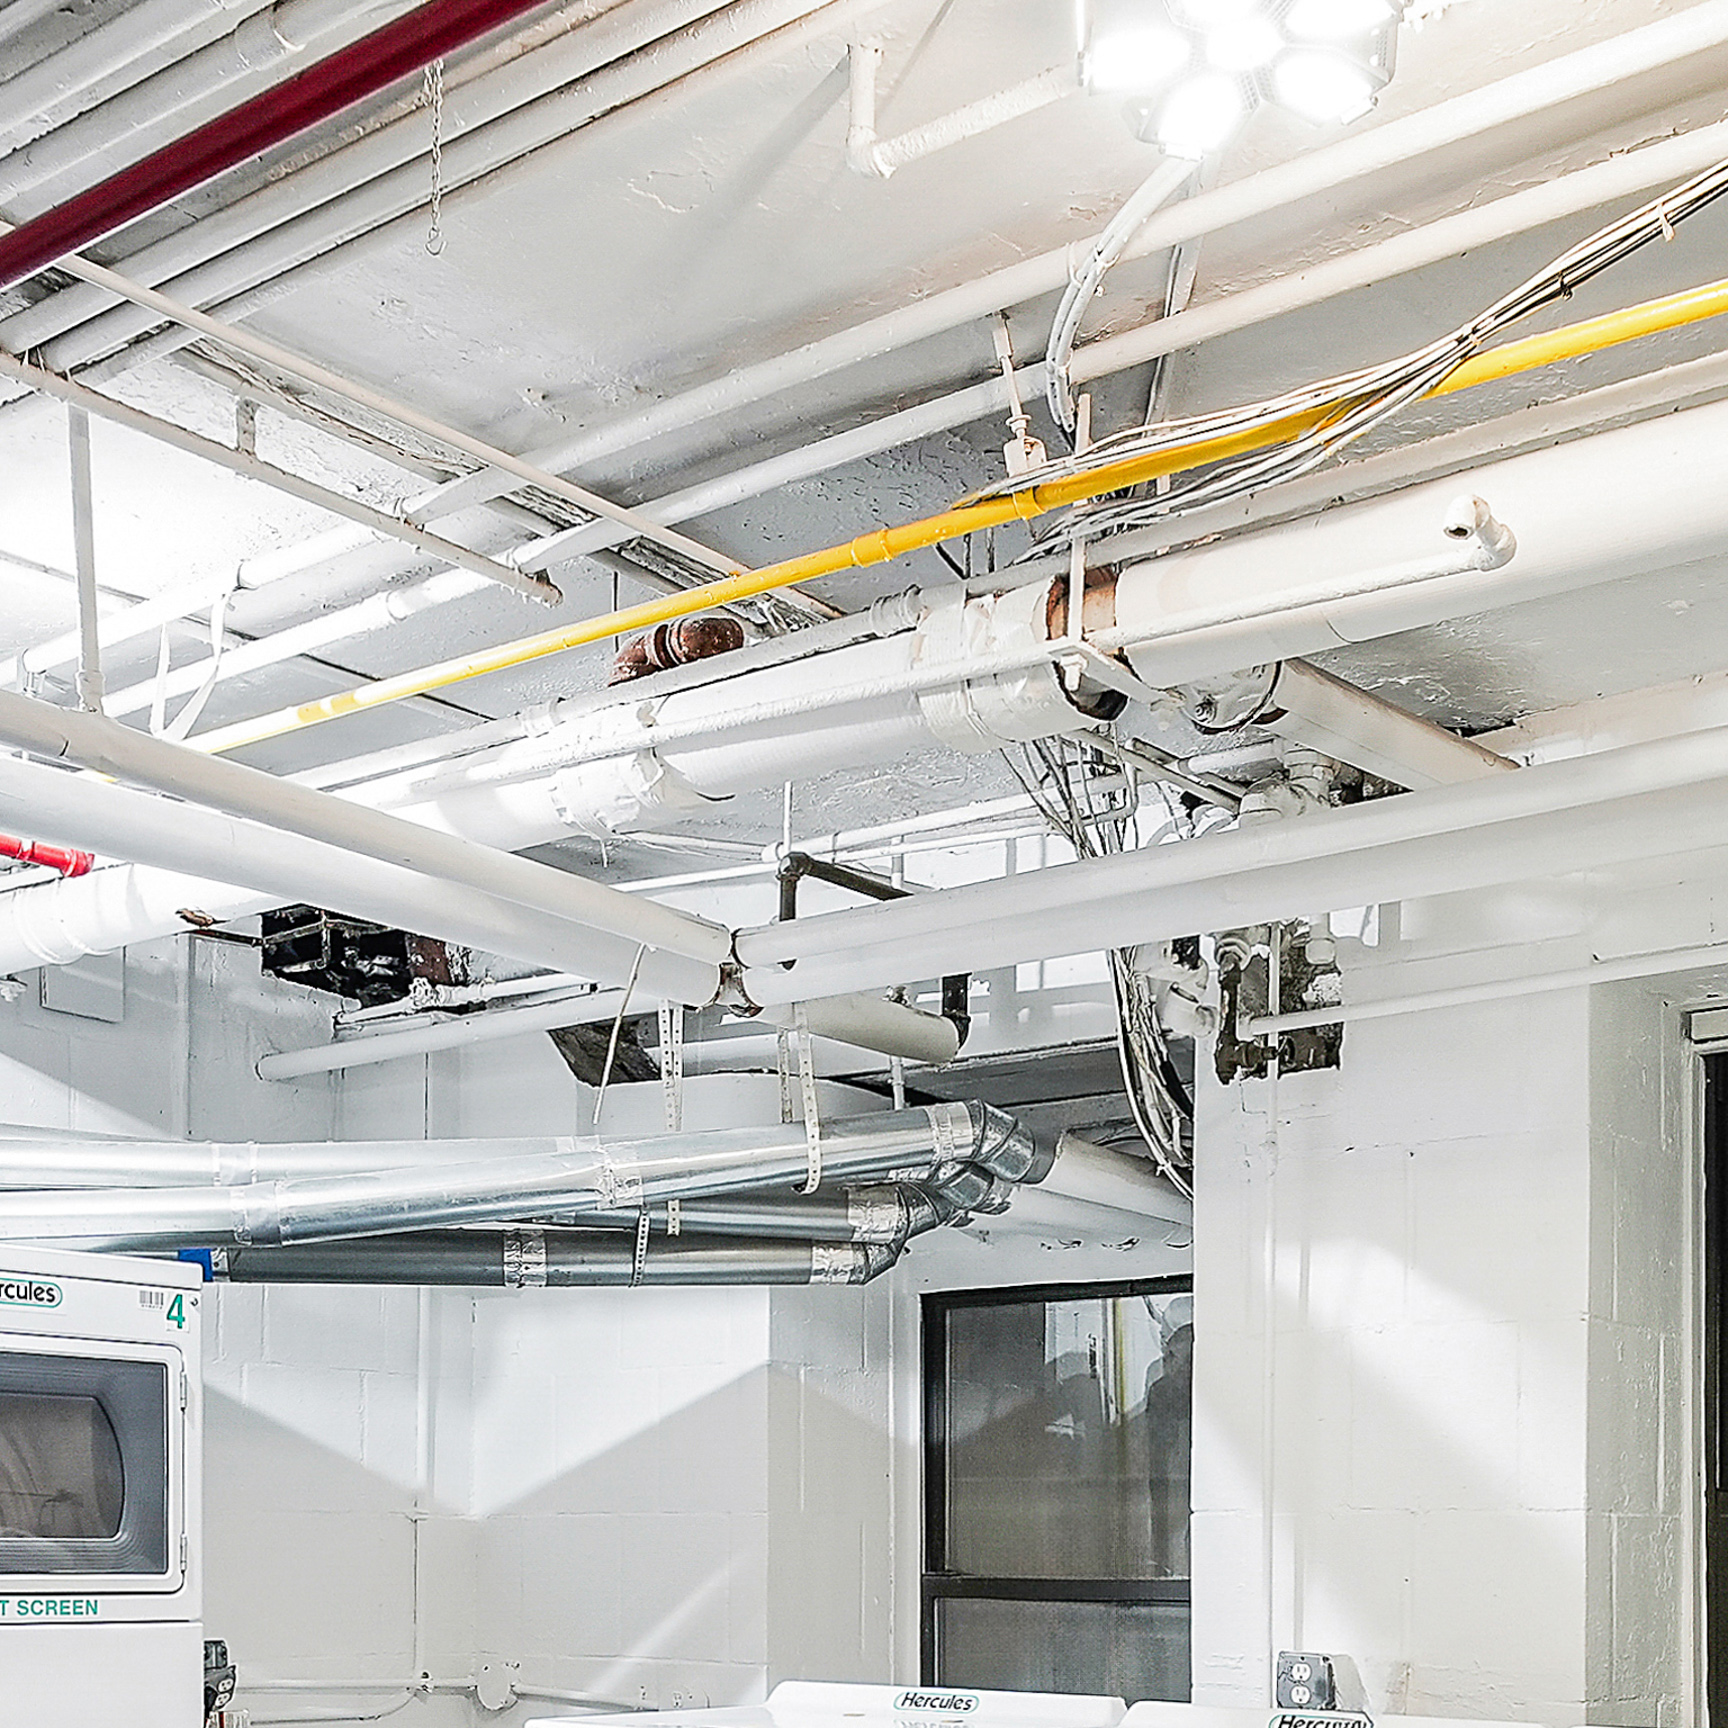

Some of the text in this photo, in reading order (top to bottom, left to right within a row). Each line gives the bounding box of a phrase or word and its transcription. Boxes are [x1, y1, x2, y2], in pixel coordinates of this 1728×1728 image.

[166, 1293, 186, 1329] 4
[17, 1599, 98, 1616] SCREEN
[900, 1692, 973, 1711] Hercules
